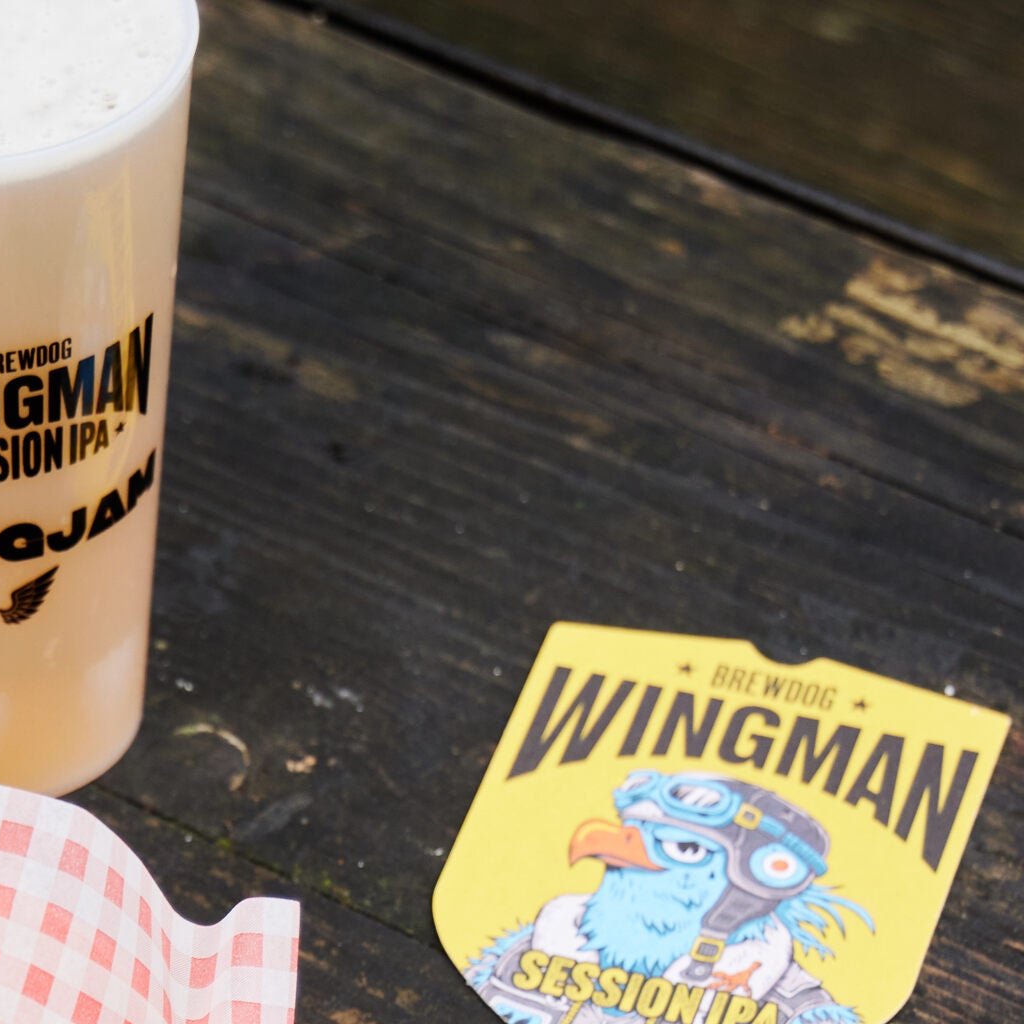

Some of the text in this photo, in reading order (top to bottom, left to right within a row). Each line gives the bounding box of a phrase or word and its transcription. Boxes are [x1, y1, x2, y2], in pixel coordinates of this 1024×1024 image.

[69, 419, 109, 466] IPA
[710, 664, 838, 711] BREWDOG
[505, 666, 980, 874] WINGMAN
